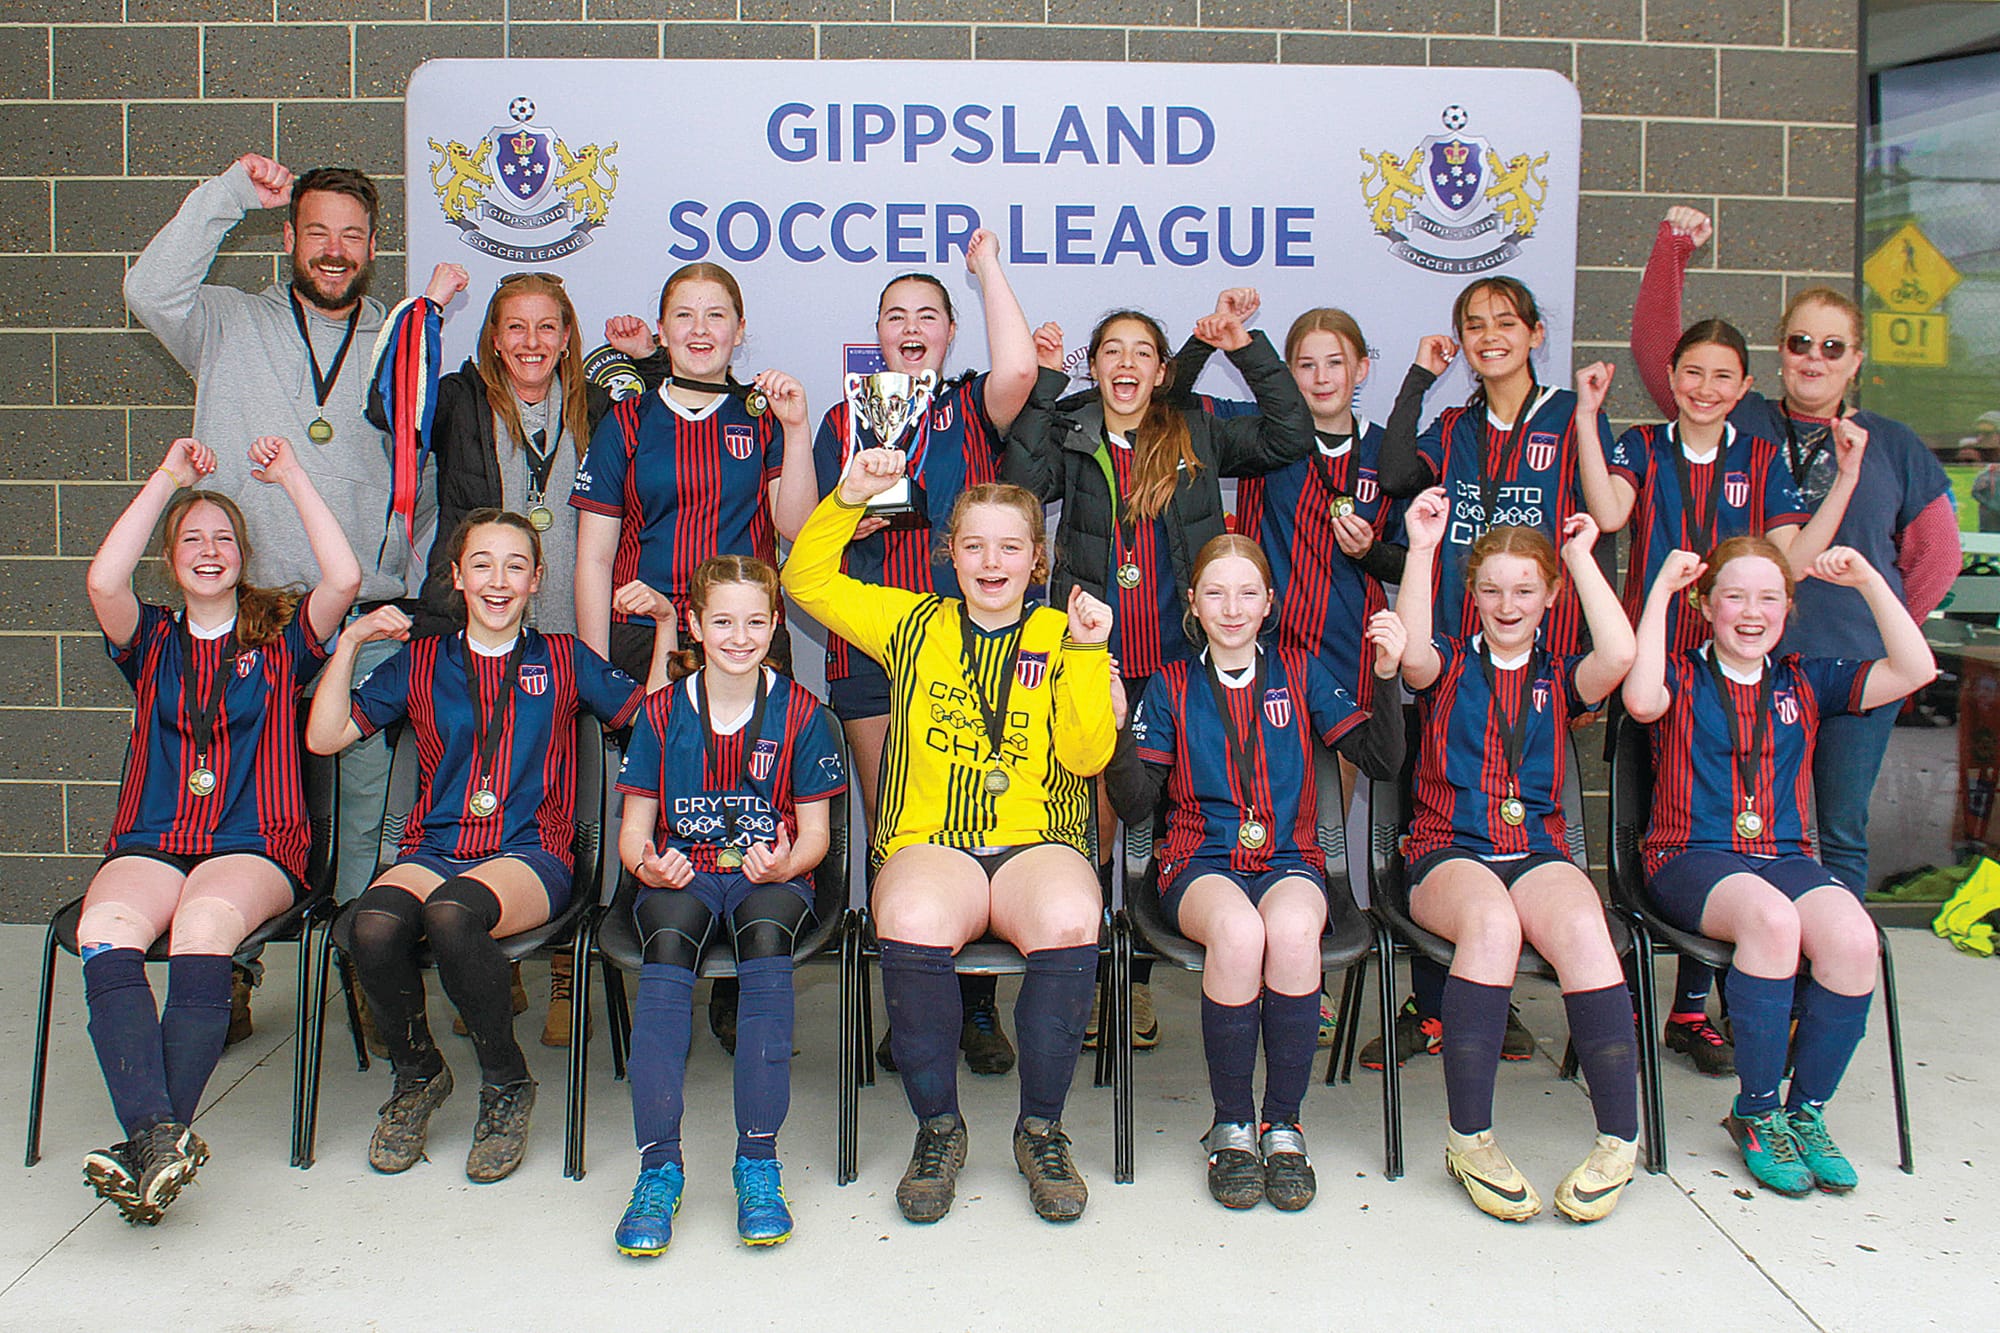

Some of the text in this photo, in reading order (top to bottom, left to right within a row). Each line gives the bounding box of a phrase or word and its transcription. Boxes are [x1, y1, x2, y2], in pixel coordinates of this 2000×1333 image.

[767, 103, 1214, 164] GIPPSLAND
[488, 207, 565, 227] GIPPSLAND
[669, 201, 1314, 267] SOCCER LEAGUE
[470, 235, 583, 260] SOCCER LEAGUE
[1400, 246, 1513, 272] SOCCER LEAGUE
[1456, 480, 1542, 504] CRPTO
[930, 681, 1029, 728] CRYO
